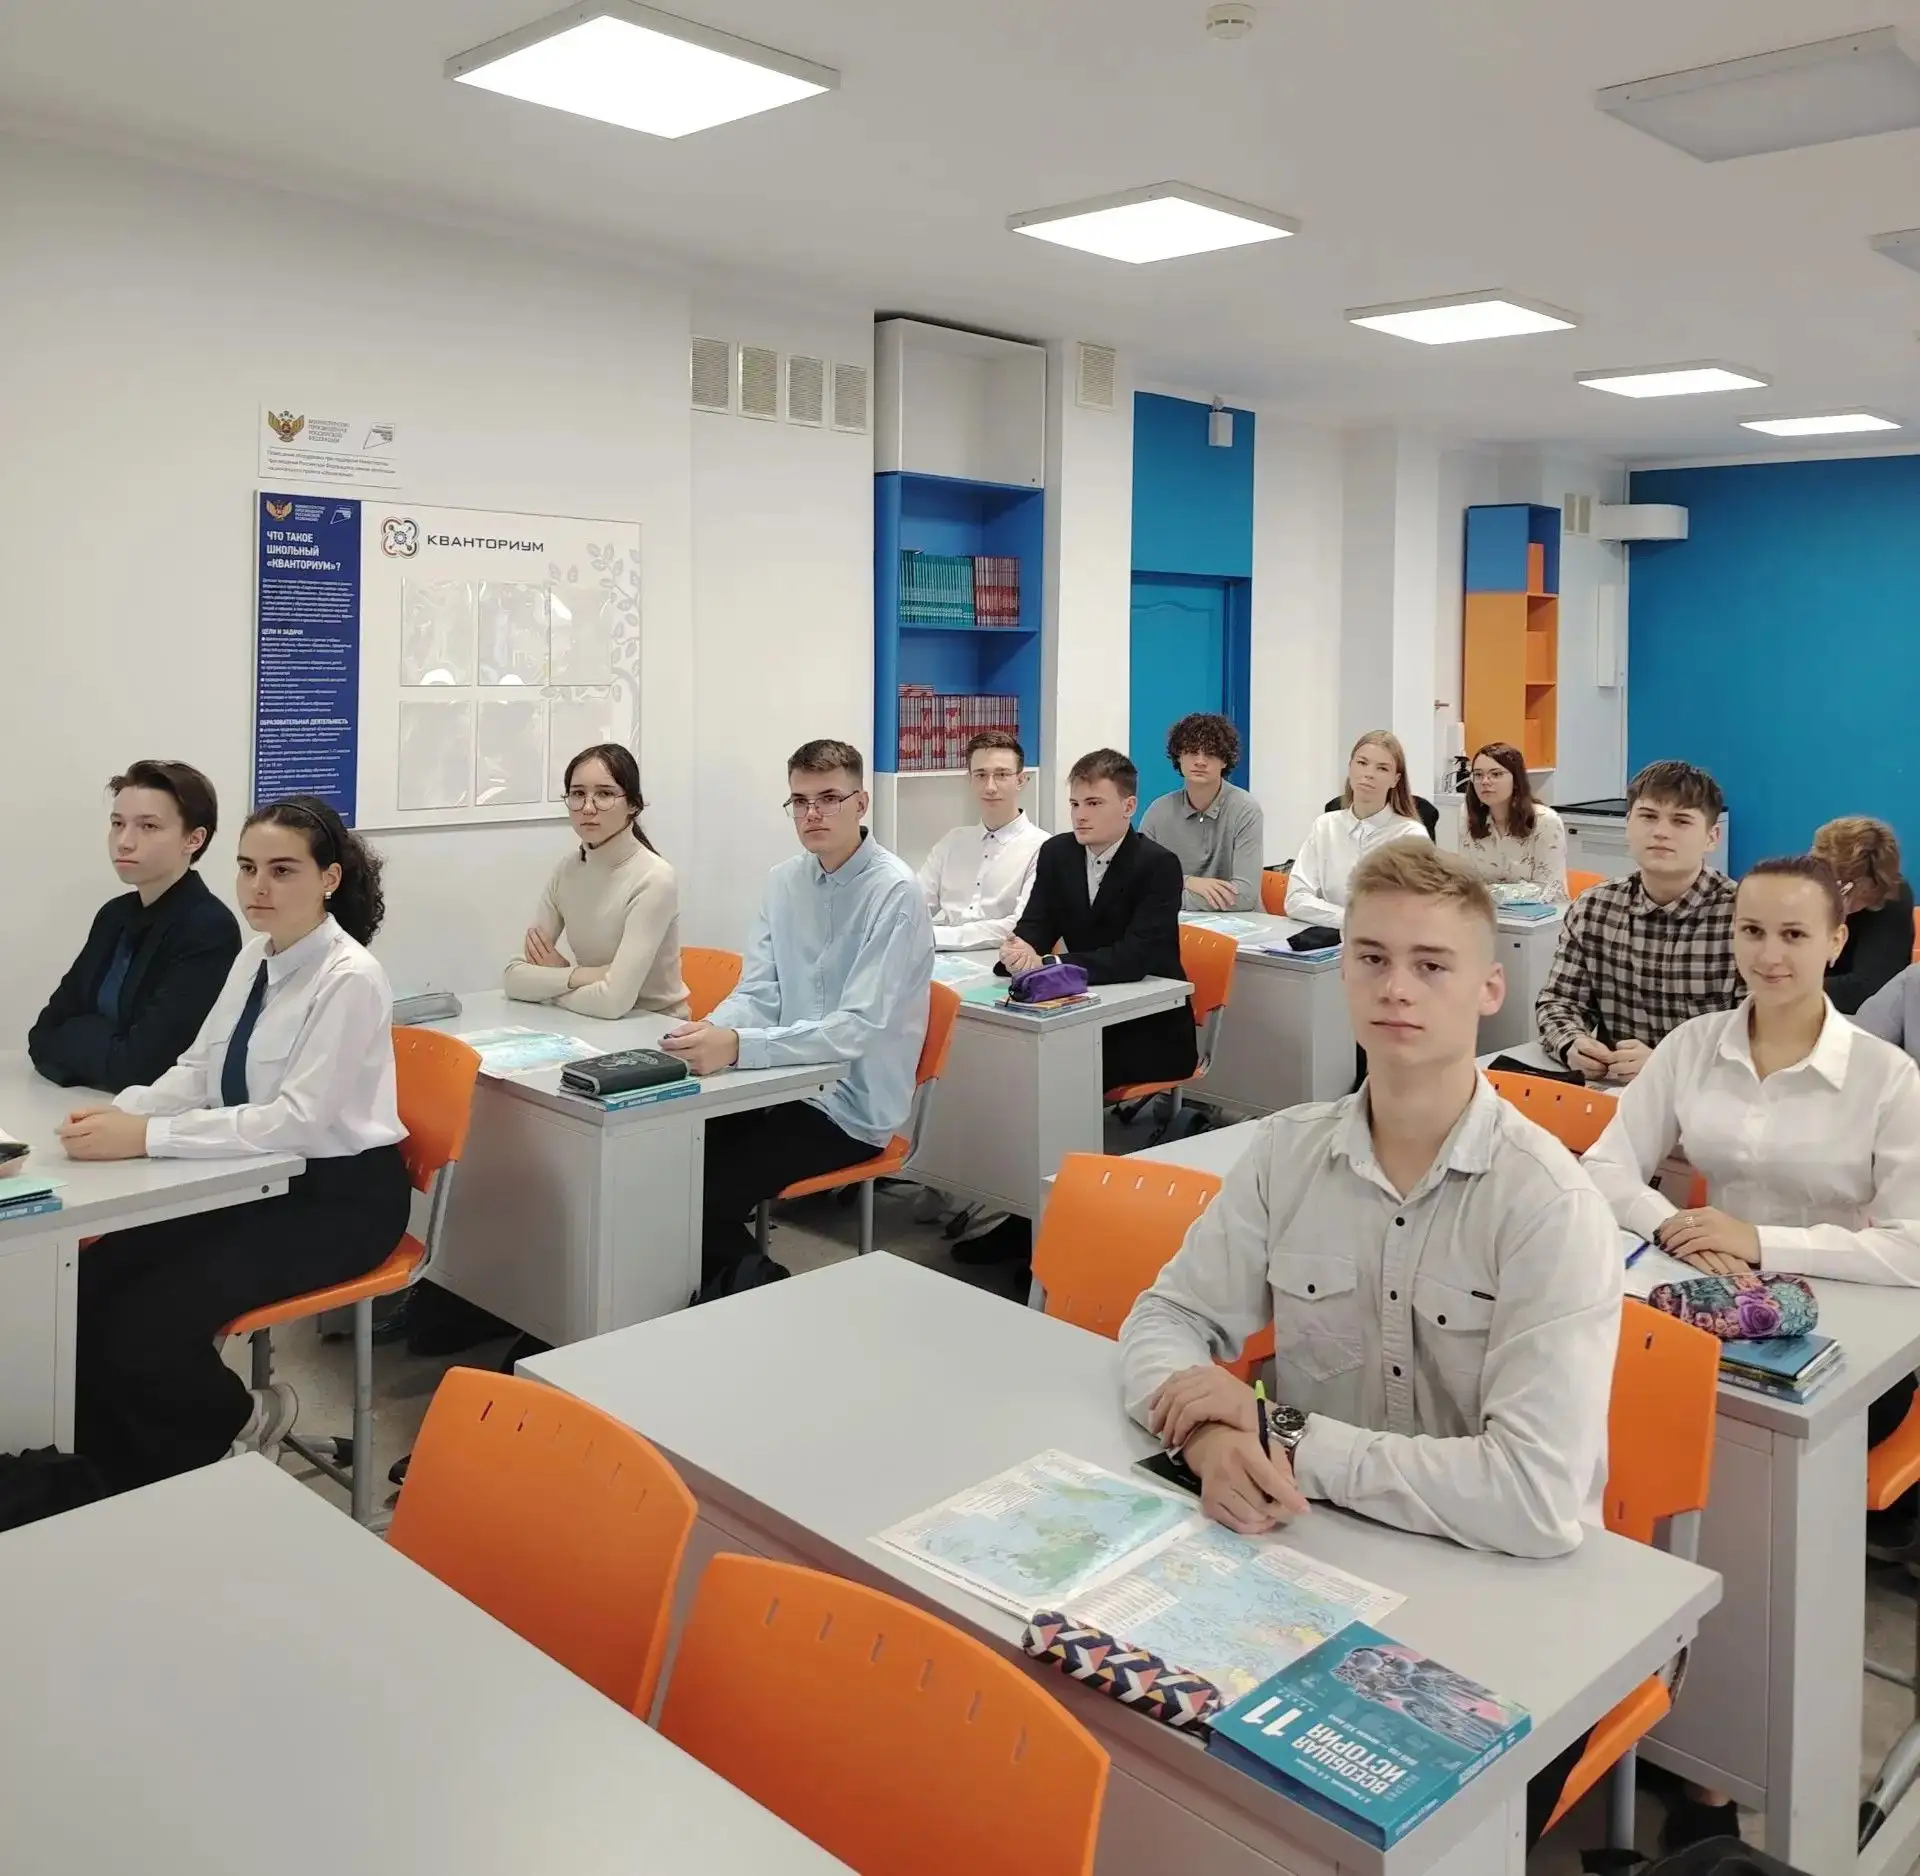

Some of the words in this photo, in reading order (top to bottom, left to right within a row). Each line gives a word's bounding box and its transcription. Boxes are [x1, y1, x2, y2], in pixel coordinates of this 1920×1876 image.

[266, 530, 284, 541] ЧТО
[285, 531, 314, 543] ТАКОЕ
[427, 534, 544, 552] КВАНТОРИУМ
[266, 544, 320, 557] ШКОЛЬНЫЙ
[266, 558, 341, 571] «КВАНТОРИУМ»?
[1240, 1696, 1303, 1737] 11
[1305, 1723, 1408, 1783] ИСТОРИЯ
[1291, 1735, 1392, 1795] ВСЕОБЩАЯ
